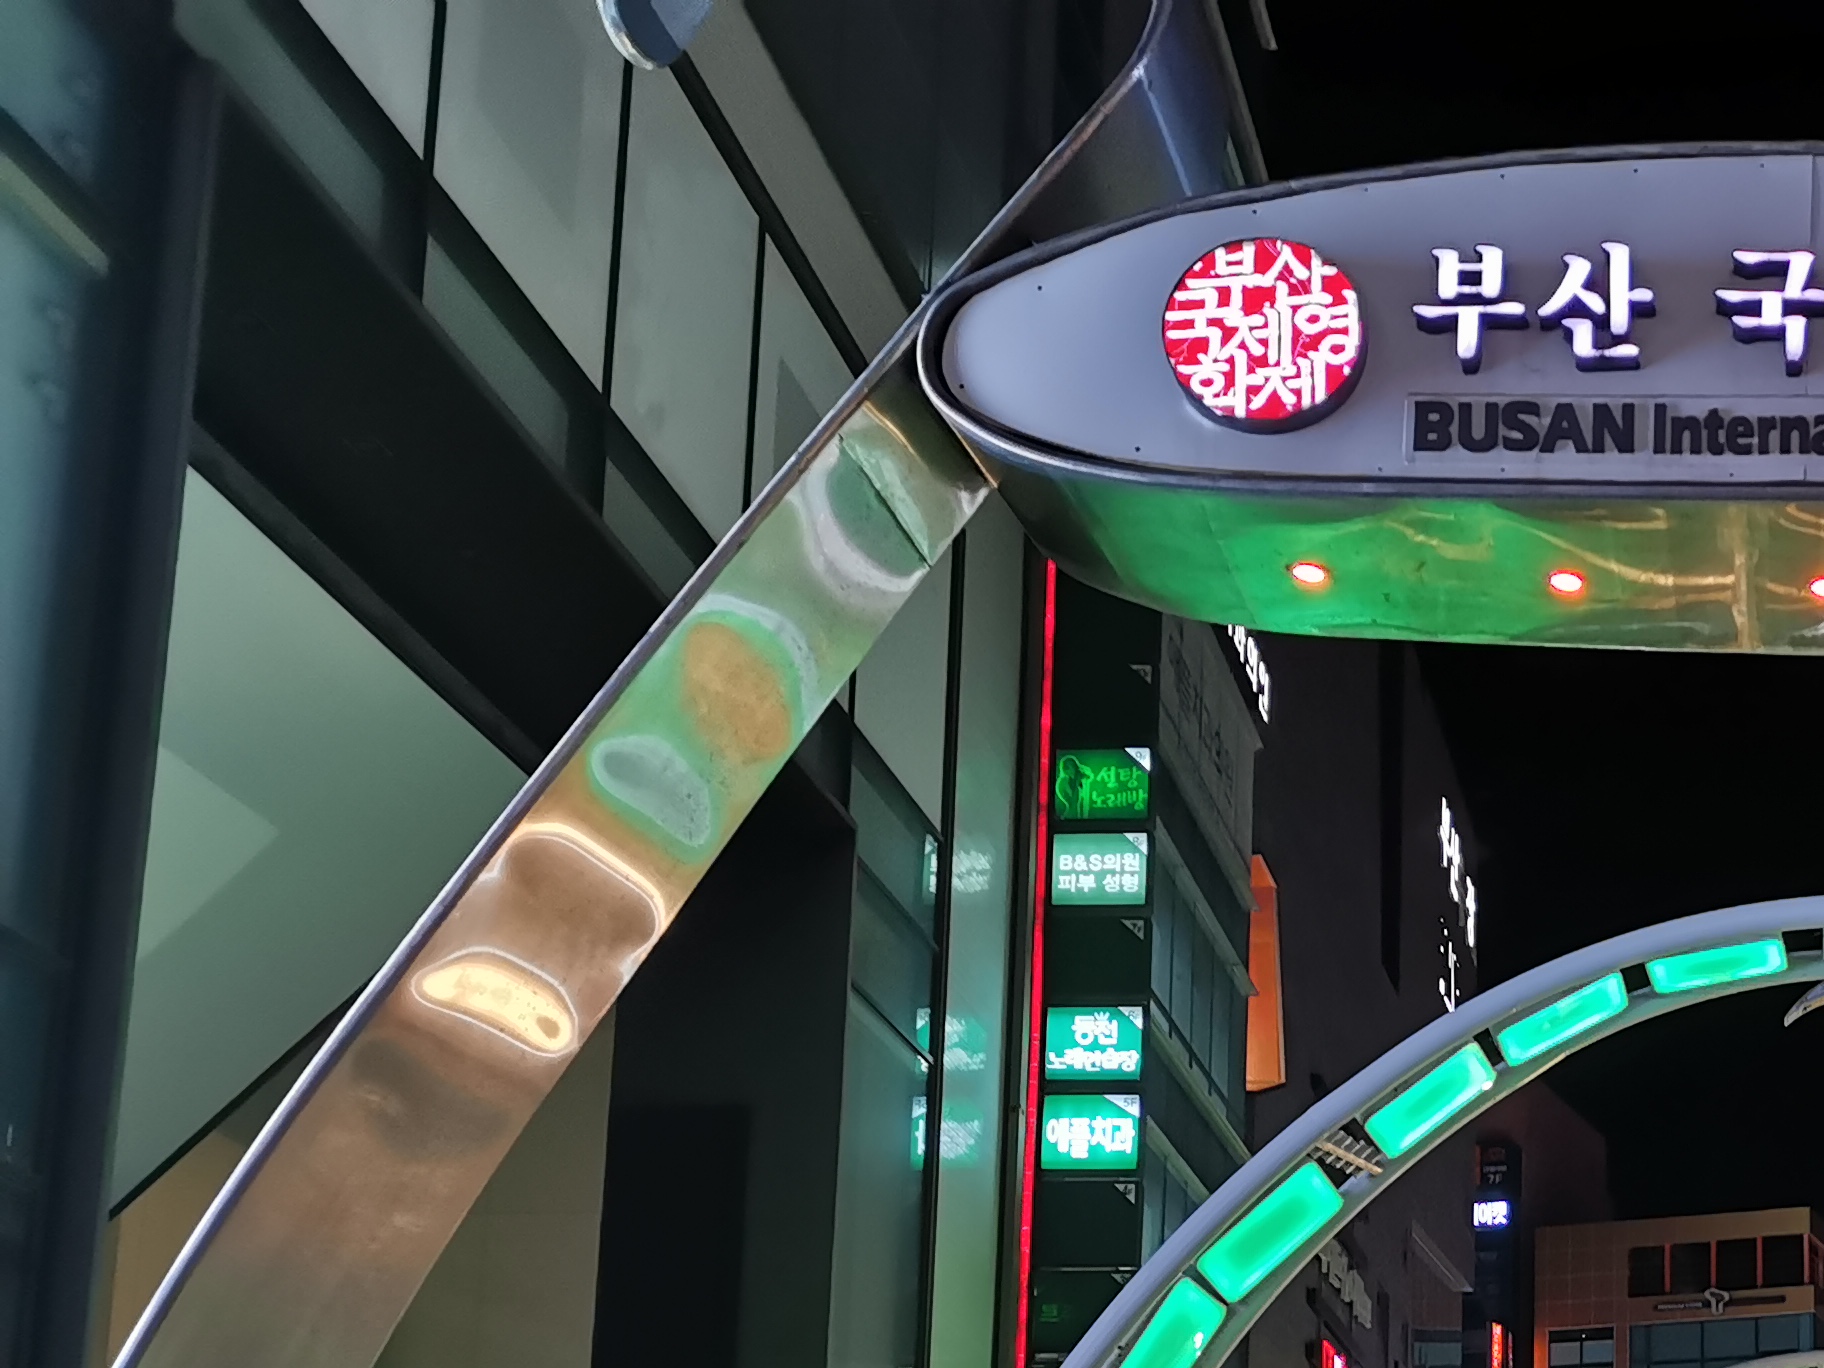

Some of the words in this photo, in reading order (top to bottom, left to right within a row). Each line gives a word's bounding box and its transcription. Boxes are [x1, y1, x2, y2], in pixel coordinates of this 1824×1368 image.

[1412, 241, 1656, 374] 부산
[1413, 401, 1635, 454] BUSAN
[1059, 852, 1140, 872] B&S의원
[1058, 873, 1097, 893] 피부
[1102, 873, 1139, 893] 성형
[1123, 1096, 1138, 1108] 5F
[1046, 1115, 1136, 1159] 애플치과
